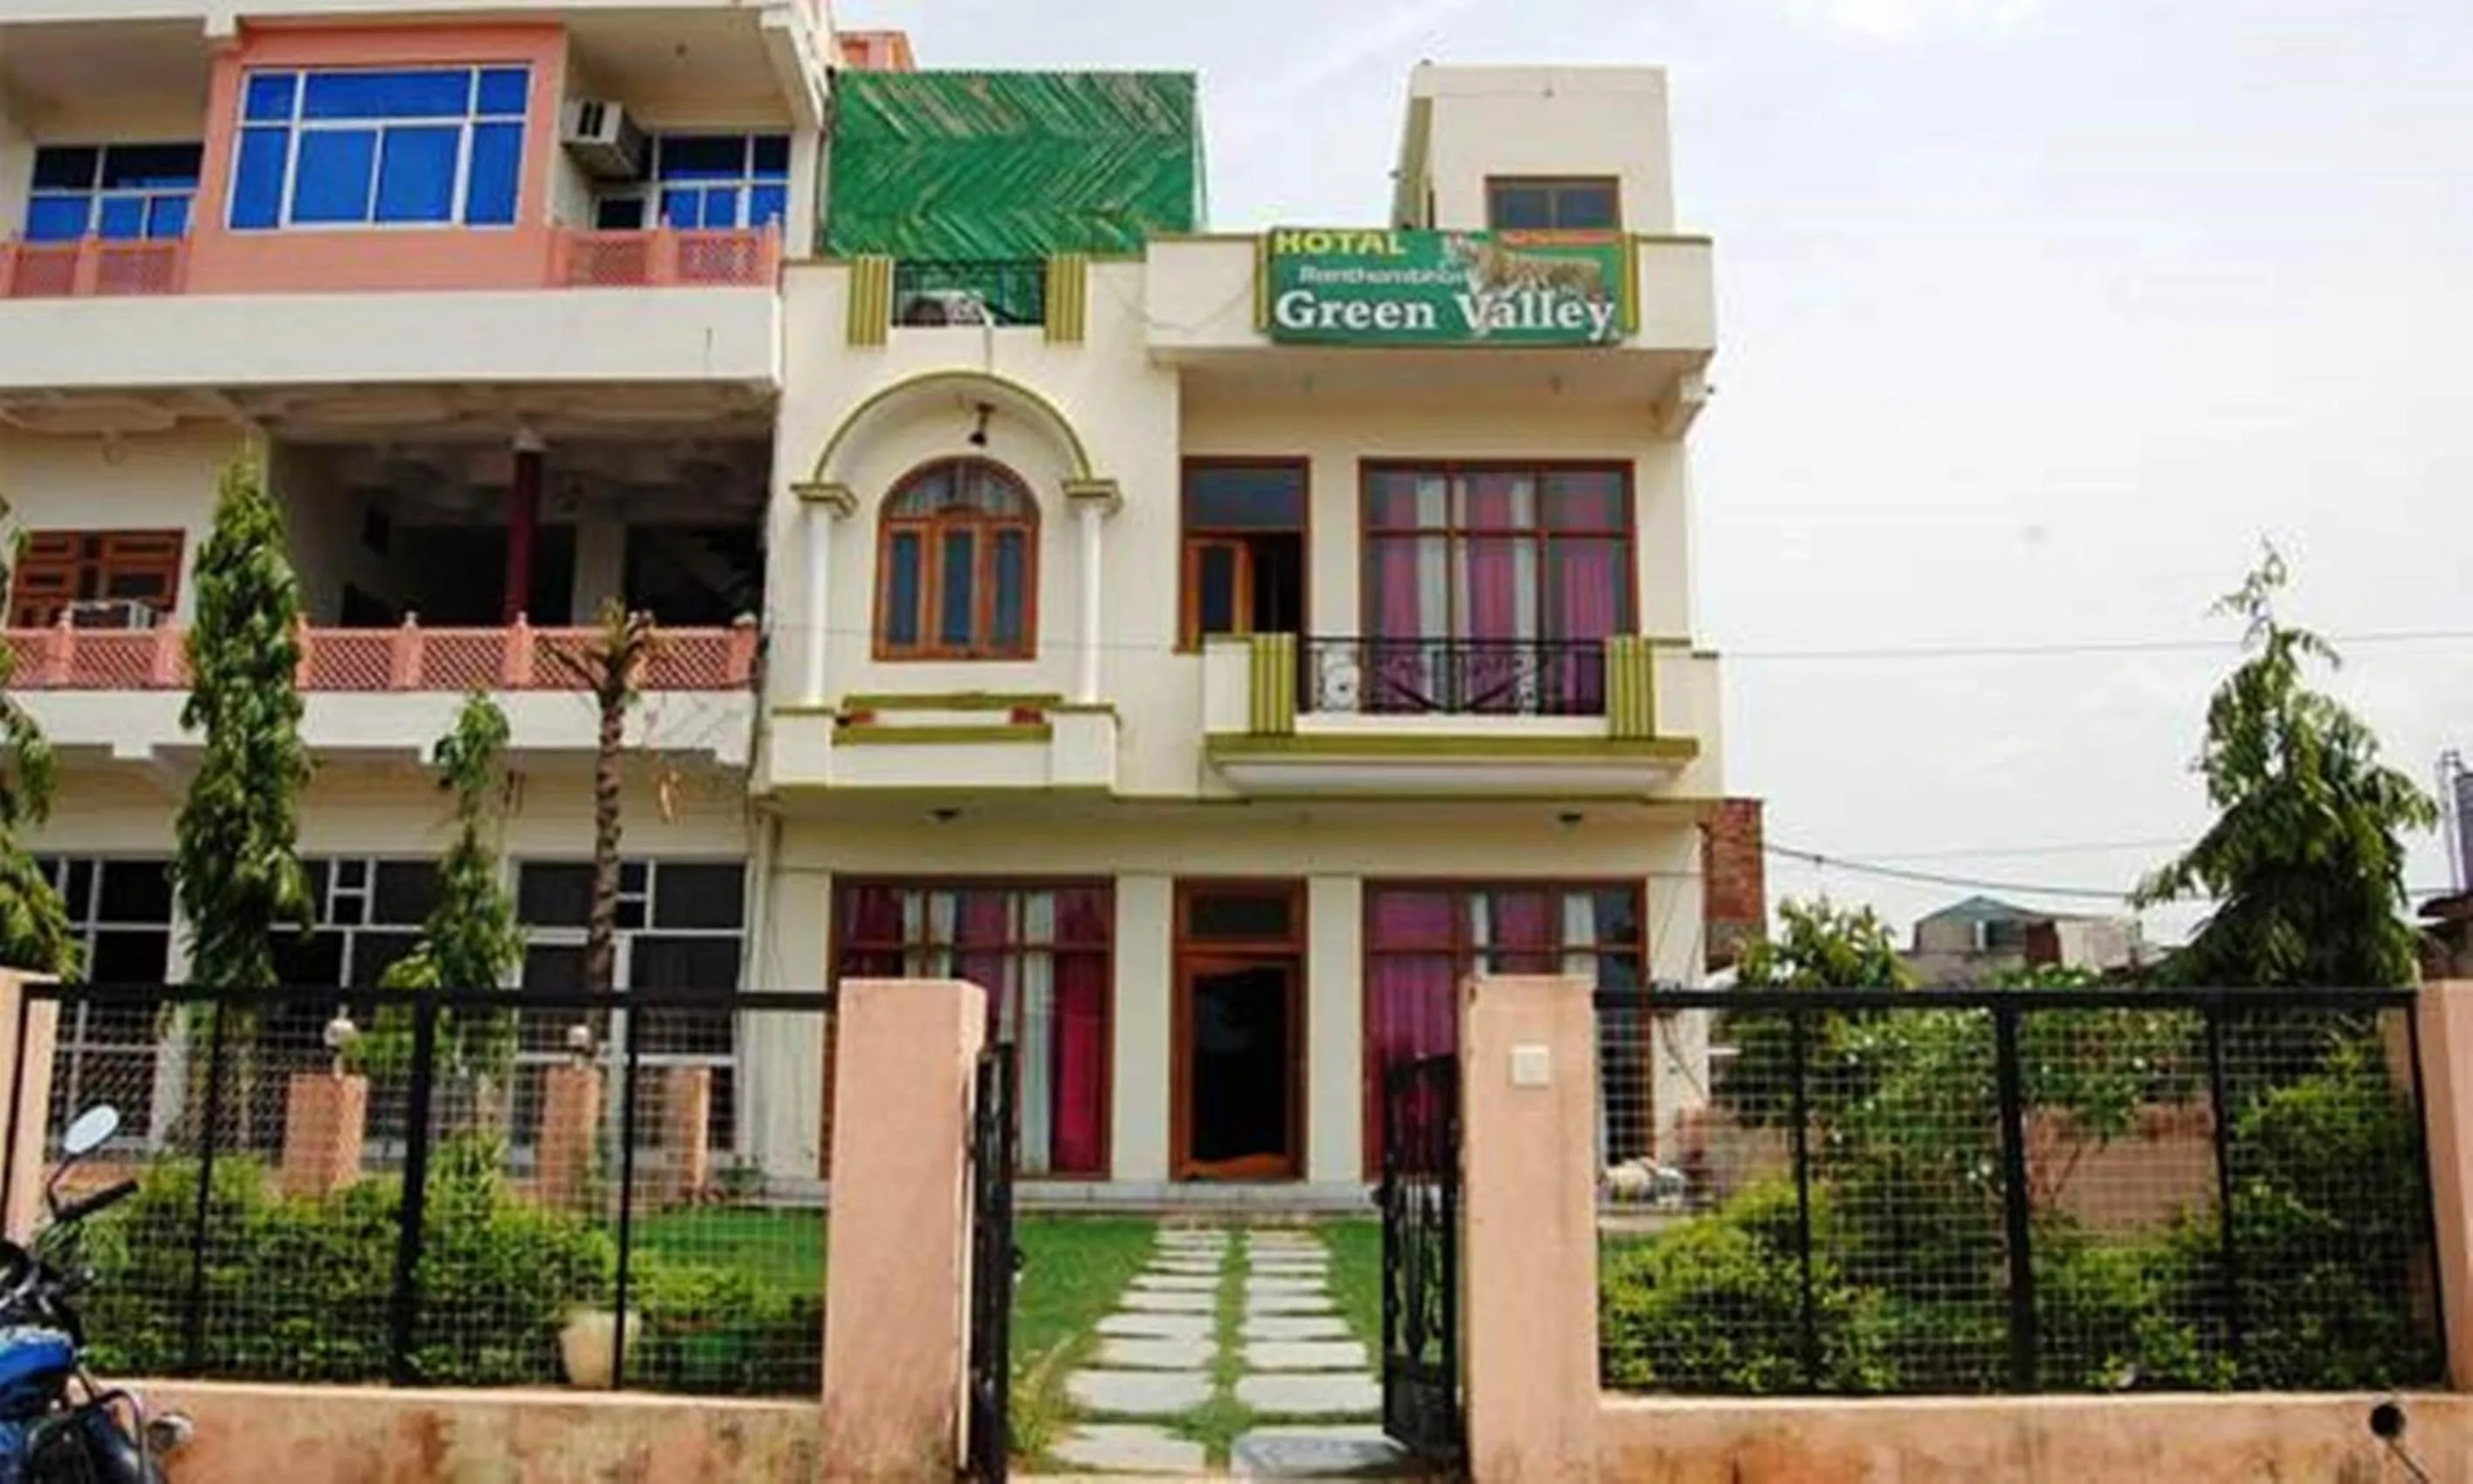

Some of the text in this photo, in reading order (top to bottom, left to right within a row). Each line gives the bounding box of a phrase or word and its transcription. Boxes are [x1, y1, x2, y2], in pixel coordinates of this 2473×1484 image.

[1274, 230, 1407, 255] HOTAL
[1275, 291, 1616, 340] Green Valley
